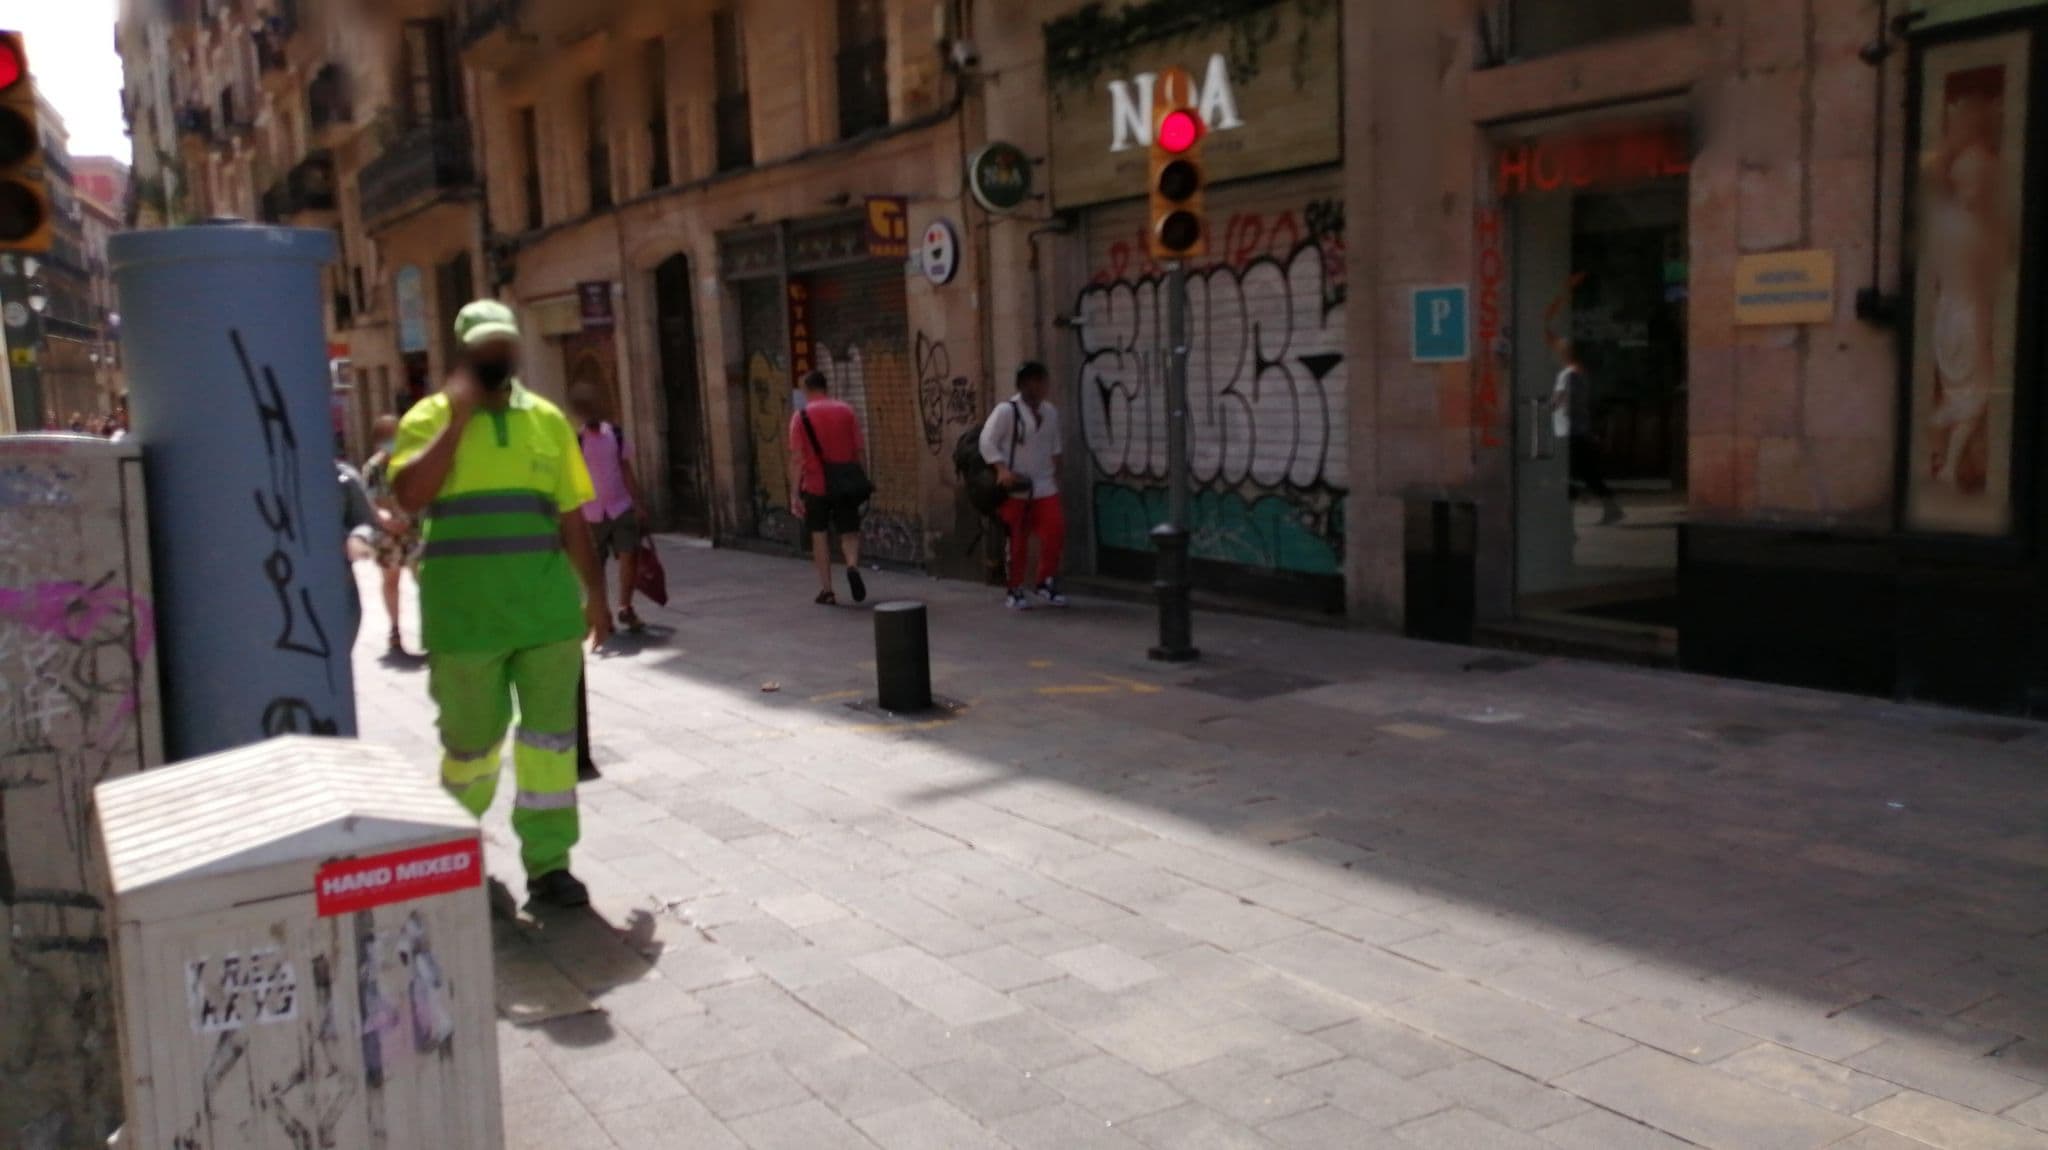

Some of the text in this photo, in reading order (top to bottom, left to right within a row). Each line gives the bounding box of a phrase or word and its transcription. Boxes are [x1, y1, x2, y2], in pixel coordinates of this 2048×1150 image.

[1431, 299, 1451, 337] P
[1479, 207, 1503, 448] HOSTAL
[322, 852, 470, 896] HAND MIXED
